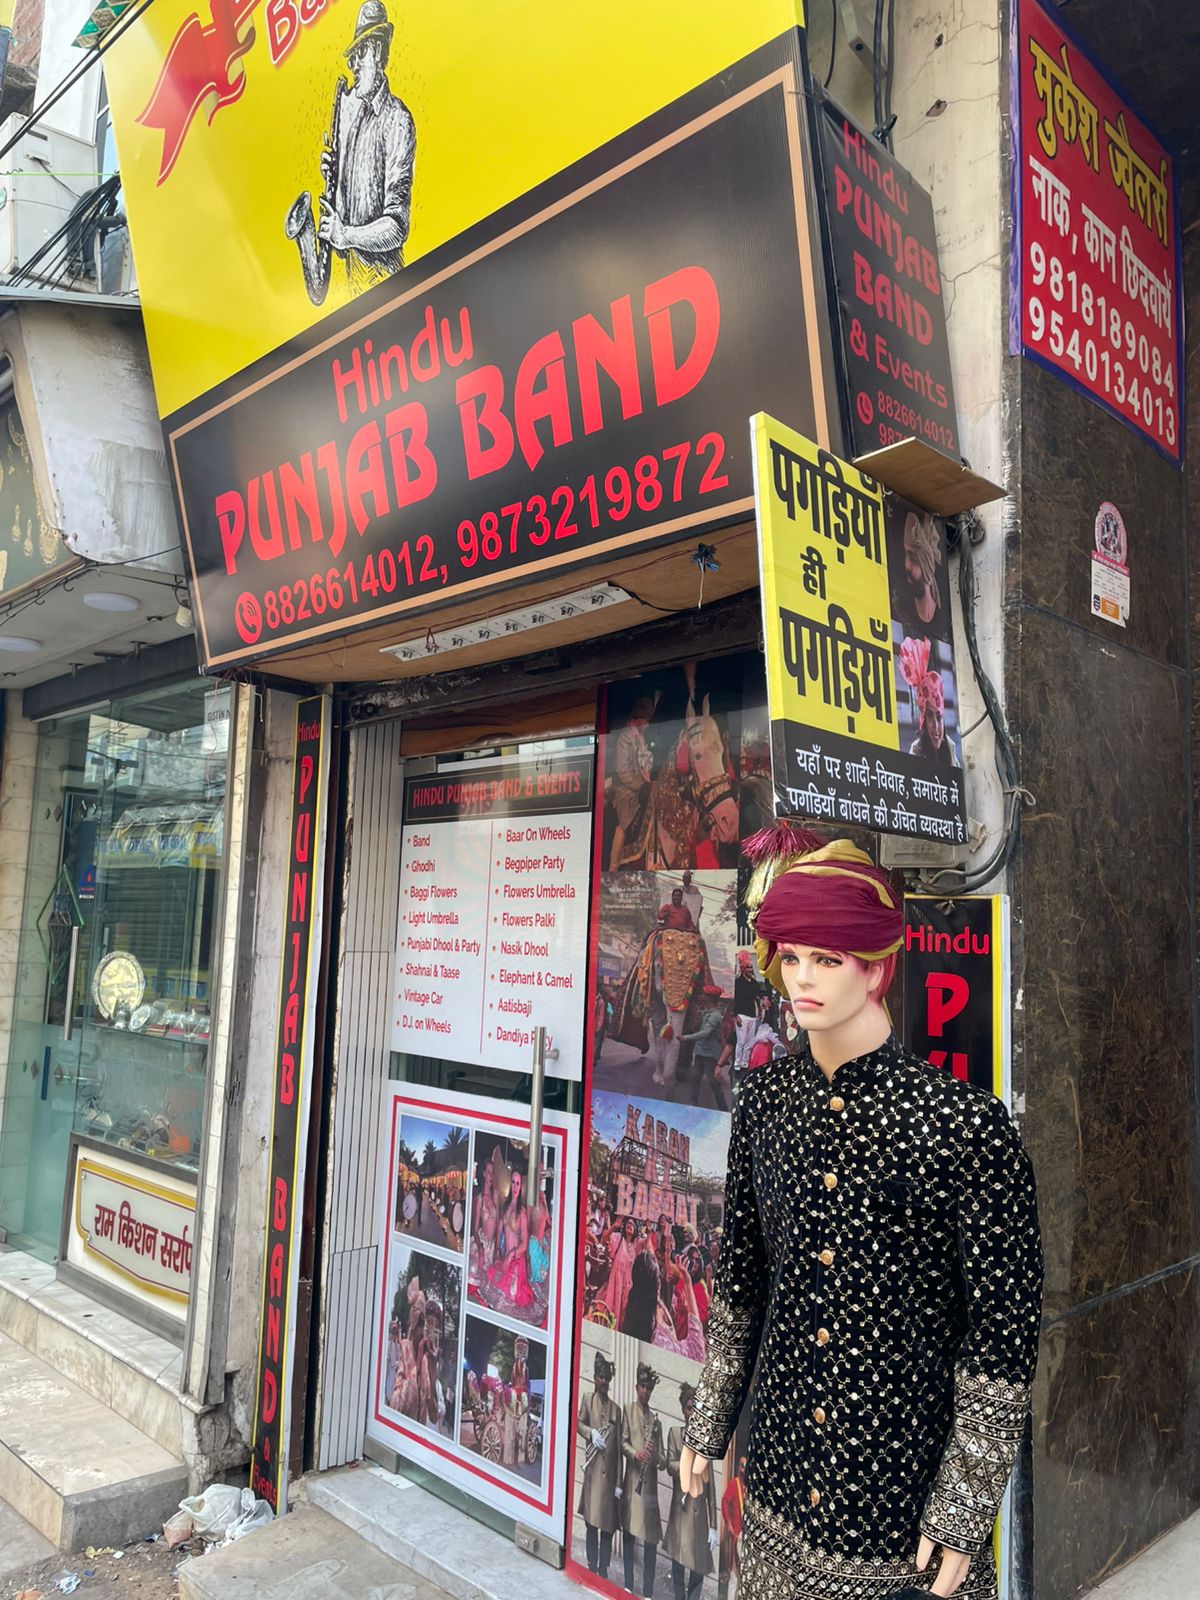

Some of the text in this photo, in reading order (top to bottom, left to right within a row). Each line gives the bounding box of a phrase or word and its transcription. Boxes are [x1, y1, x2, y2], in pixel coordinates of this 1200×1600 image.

[1029, 34, 1170, 249] मुकेश ज्वैलर्स
[842, 119, 908, 215] Hindu
[834, 165, 942, 295] PUNJAB
[1029, 155, 1173, 339] नाक, कान छिदवायें
[853, 251, 934, 346] BAND
[1029, 241, 1175, 398] 9818189084
[332, 305, 474, 423] Hindu
[849, 318, 948, 409] & Events
[1029, 296, 1176, 446] 9540134013
[215, 267, 721, 575] PUNJAB BAND
[878, 390, 954, 450] 8826614012
[770, 437, 883, 565] पगड़ियाँ
[264, 533, 449, 632] 8826614012,
[456, 431, 730, 569] 9873219872
[799, 545, 828, 600] ही
[778, 603, 894, 734] पगड़ियाँ
[297, 721, 321, 744] Hindu
[413, 770, 581, 809] HINDU PUNJAB BAND & EVENTS
[795, 744, 821, 775] यहाँ
[824, 755, 841, 780] पर
[911, 776, 949, 807] समारोह
[950, 780, 959, 807] में
[787, 782, 836, 820] पगड़ियाँ
[838, 792, 871, 824] बांधने
[873, 798, 888, 827] की
[891, 802, 917, 833] उचित
[919, 814, 955, 840] व्यवस्था
[413, 834, 431, 847] Band
[506, 826, 571, 843] Baar On Wheels
[411, 859, 436, 873] Ghodhi
[504, 855, 565, 873] Begpiper Party
[410, 885, 458, 901] Baggi Flowers
[503, 884, 576, 899] Flowers Umbrella
[408, 912, 459, 927] Light Umbrella
[502, 913, 556, 928] Flowers Palki
[905, 924, 990, 954] Hindu
[407, 937, 481, 956] Punjabi Dhool & Party
[500, 942, 549, 957] Nasik Dhool
[405, 963, 460, 979] Shahnai & Taase
[499, 969, 573, 988] Elephant & Camel
[404, 989, 443, 1006] Vintage Car
[497, 997, 533, 1018] Aatisbaji
[415, 1019, 424, 1030] on
[425, 1017, 452, 1033] Wheels
[496, 1027, 529, 1047] Dandiya
[94, 1203, 116, 1242] राम
[117, 1199, 158, 1261] किशन
